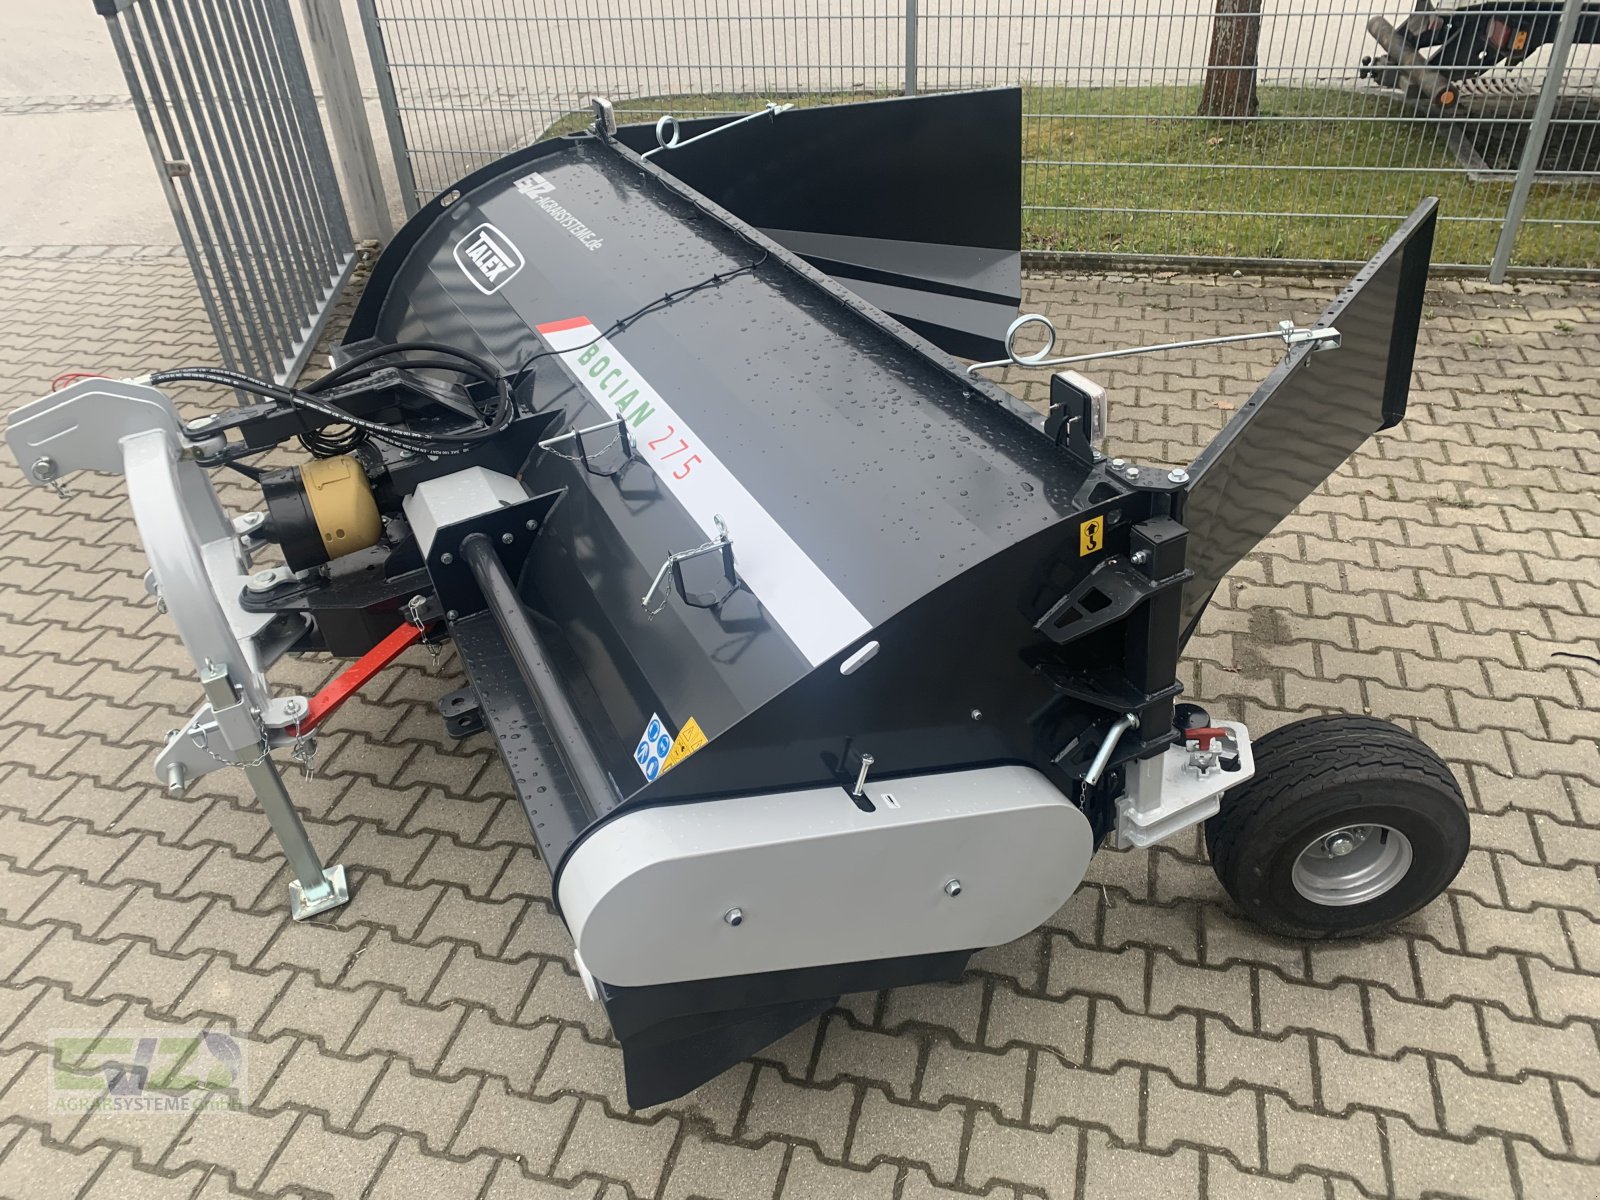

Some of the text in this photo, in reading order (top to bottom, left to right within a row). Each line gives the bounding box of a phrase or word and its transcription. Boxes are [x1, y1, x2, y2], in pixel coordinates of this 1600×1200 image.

[464, 230, 516, 283] TALEX
[577, 343, 702, 480] BOCIAN 275
